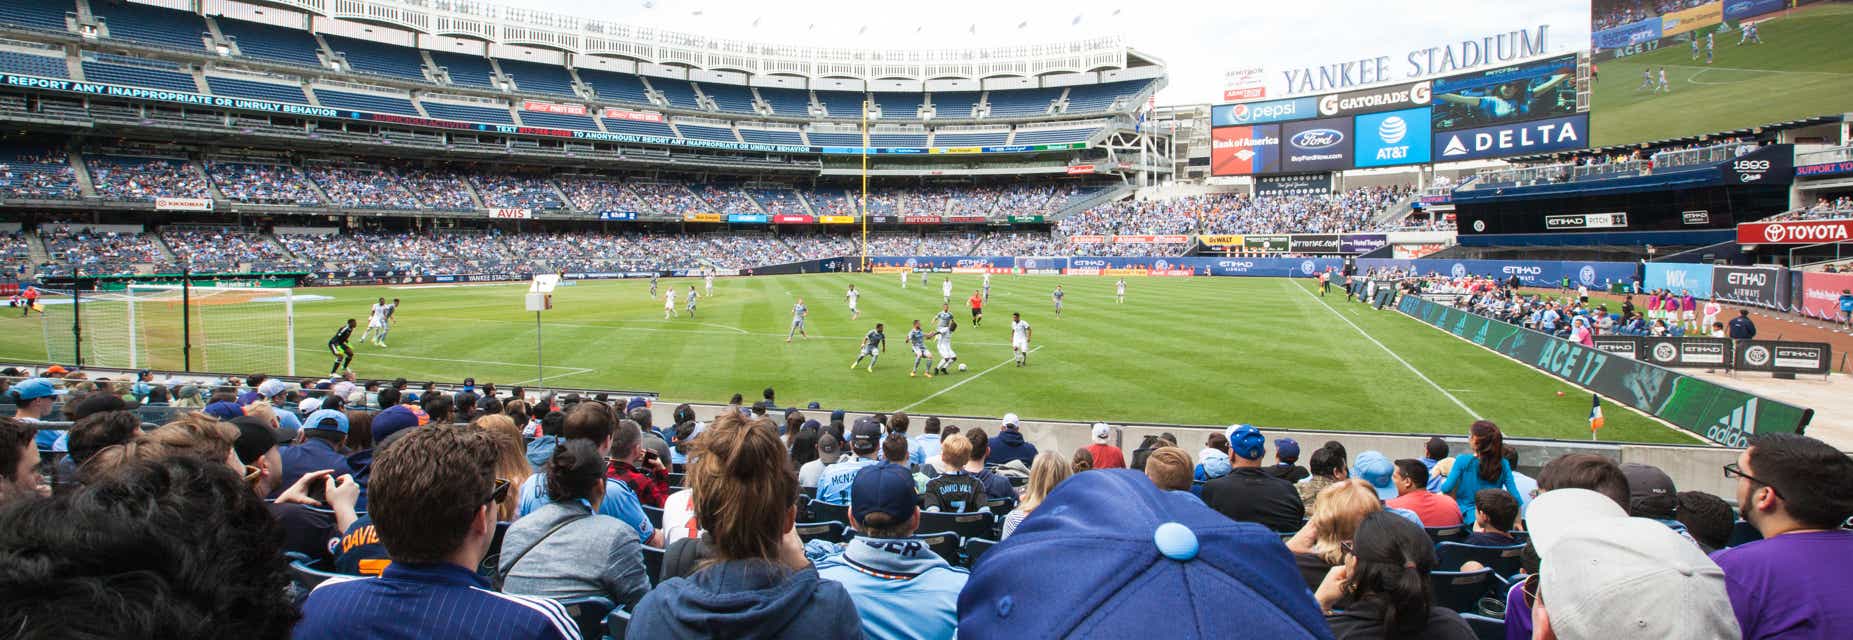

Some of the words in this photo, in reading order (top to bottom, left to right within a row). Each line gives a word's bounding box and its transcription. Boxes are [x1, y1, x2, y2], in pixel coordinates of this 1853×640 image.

[1282, 56, 1390, 92] YANKEE
[1406, 24, 1550, 78] STADIUM
[8, 76, 68, 90] REPORT
[72, 83, 105, 94] ANY
[108, 86, 212, 104] INAPPROPRIATE
[216, 96, 233, 106] OR
[236, 100, 280, 112] UNRULY
[284, 104, 337, 117] BEHAVIOR
[1340, 90, 1408, 110] GATORADE
[1252, 102, 1296, 120] pepsi
[586, 133, 640, 142] ANONYMOUSLY
[687, 140, 737, 149] INAPPROPRIATE
[1213, 138, 1233, 148] Bank
[1235, 138, 1244, 147] of
[1244, 136, 1279, 146] America
[1301, 132, 1332, 146] Ford
[1476, 122, 1577, 151] DELTA
[1376, 146, 1409, 160] AT&T
[1733, 160, 1769, 170] 1893
[1798, 164, 1835, 174] SUPPORT
[498, 208, 524, 218] AVIS
[1549, 217, 1584, 226] ETIHAD
[1588, 215, 1608, 224] PITCH
[1787, 224, 1848, 240] TOYOTA
[1503, 266, 1541, 274] ETIHAD
[1728, 272, 1766, 286] ETIHAD
[1734, 289, 1760, 298] AIRWAYS
[1598, 344, 1632, 354] ETIHAD
[1538, 339, 1582, 378] ACE
[1578, 348, 1608, 385] 17
[1707, 425, 1748, 448] adida
[940, 484, 958, 494] DAVID
[951, 501, 966, 513] 7
